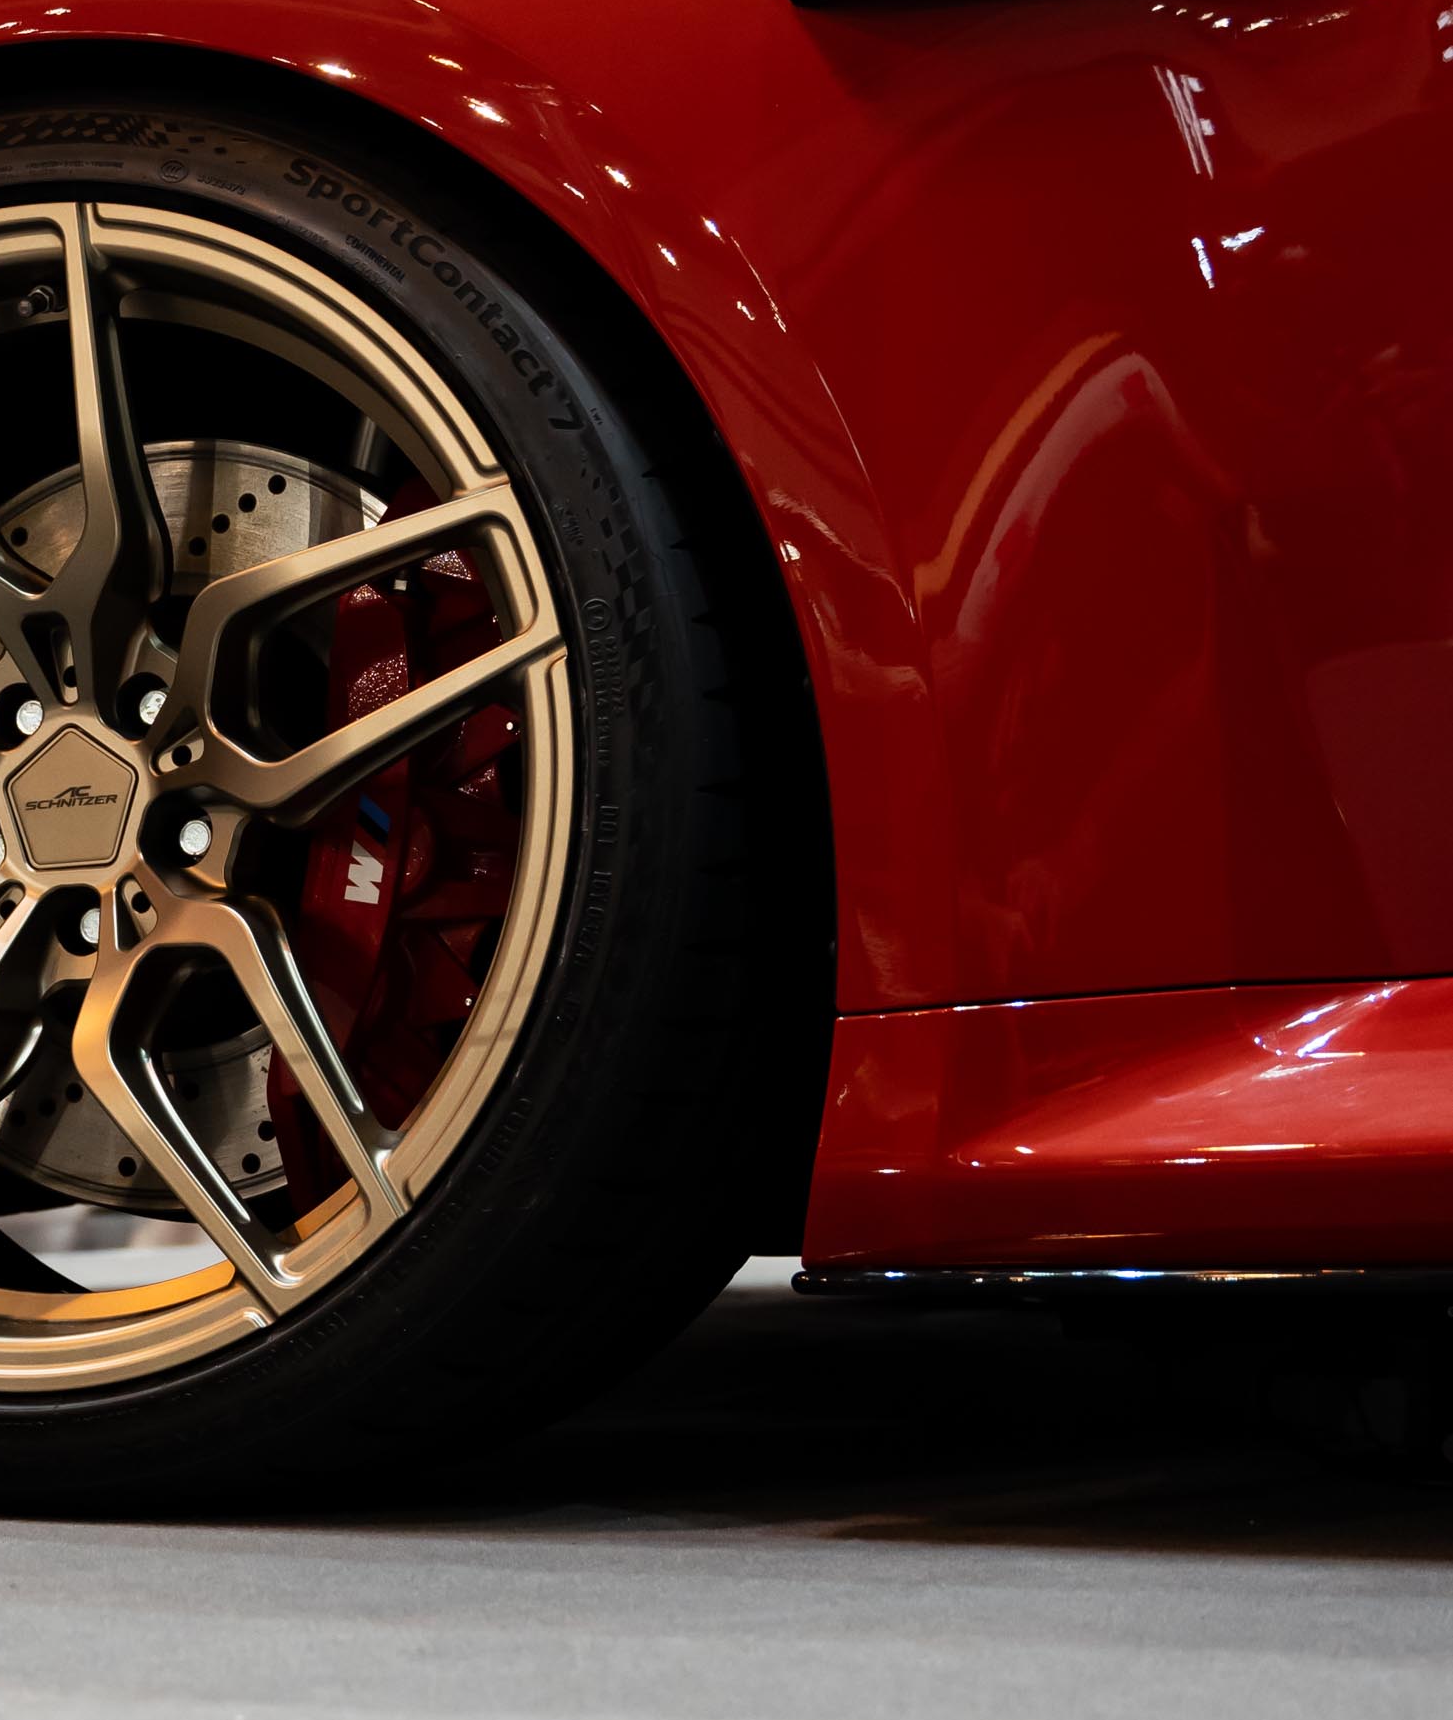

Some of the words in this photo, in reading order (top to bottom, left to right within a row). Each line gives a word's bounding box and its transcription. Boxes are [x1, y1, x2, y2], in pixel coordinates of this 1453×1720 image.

[282, 157, 556, 398] SportContact
[547, 394, 585, 433] 7
[54, 785, 92, 799] AC
[25, 794, 118, 811] SCHNITZER
